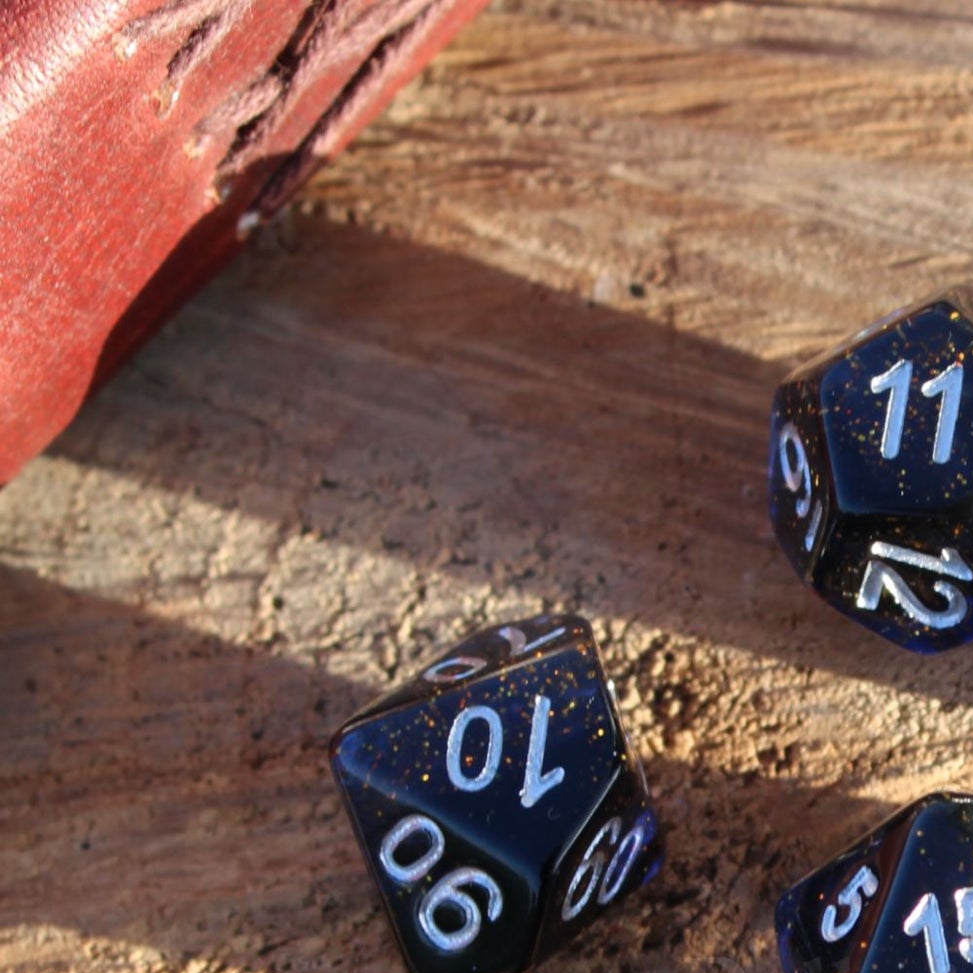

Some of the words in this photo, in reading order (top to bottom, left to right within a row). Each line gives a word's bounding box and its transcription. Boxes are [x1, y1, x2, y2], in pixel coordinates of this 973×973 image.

[870, 359, 964, 465] 11
[445, 694, 566, 809] 10
[820, 864, 880, 944] 5
